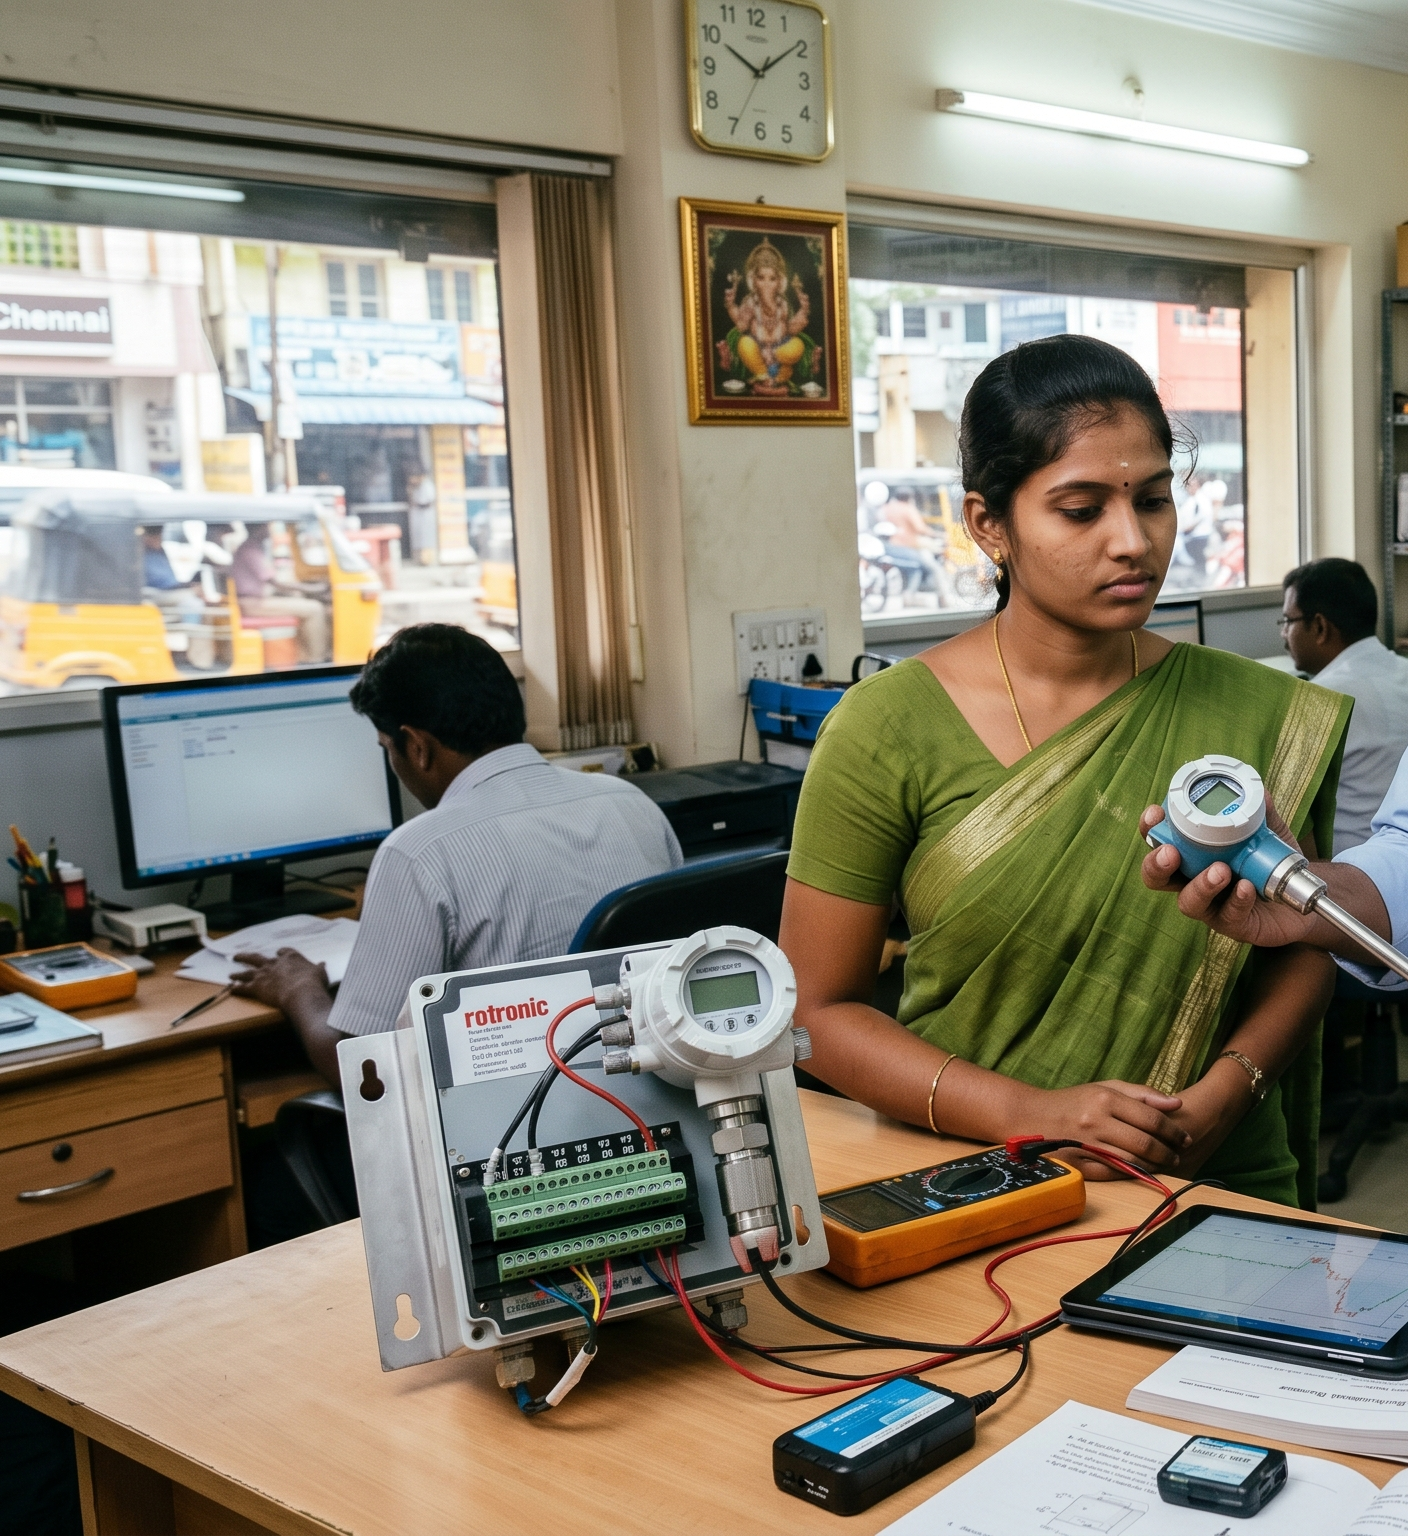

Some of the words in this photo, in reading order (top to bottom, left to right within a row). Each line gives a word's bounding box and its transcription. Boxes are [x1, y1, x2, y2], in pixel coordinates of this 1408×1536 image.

[720, 4, 736, 24] 11
[747, 7, 766, 28] 12
[781, 15, 787, 33] 1
[701, 23, 721, 44] 10
[796, 39, 808, 59] 2
[703, 56, 716, 76] 9
[799, 71, 811, 91] 3
[706, 90, 719, 110] 8
[799, 105, 811, 122] 4
[728, 116, 739, 136] 7
[754, 121, 767, 141] 6
[781, 124, 793, 144] 5
[464, 997, 549, 1028] rotronic
